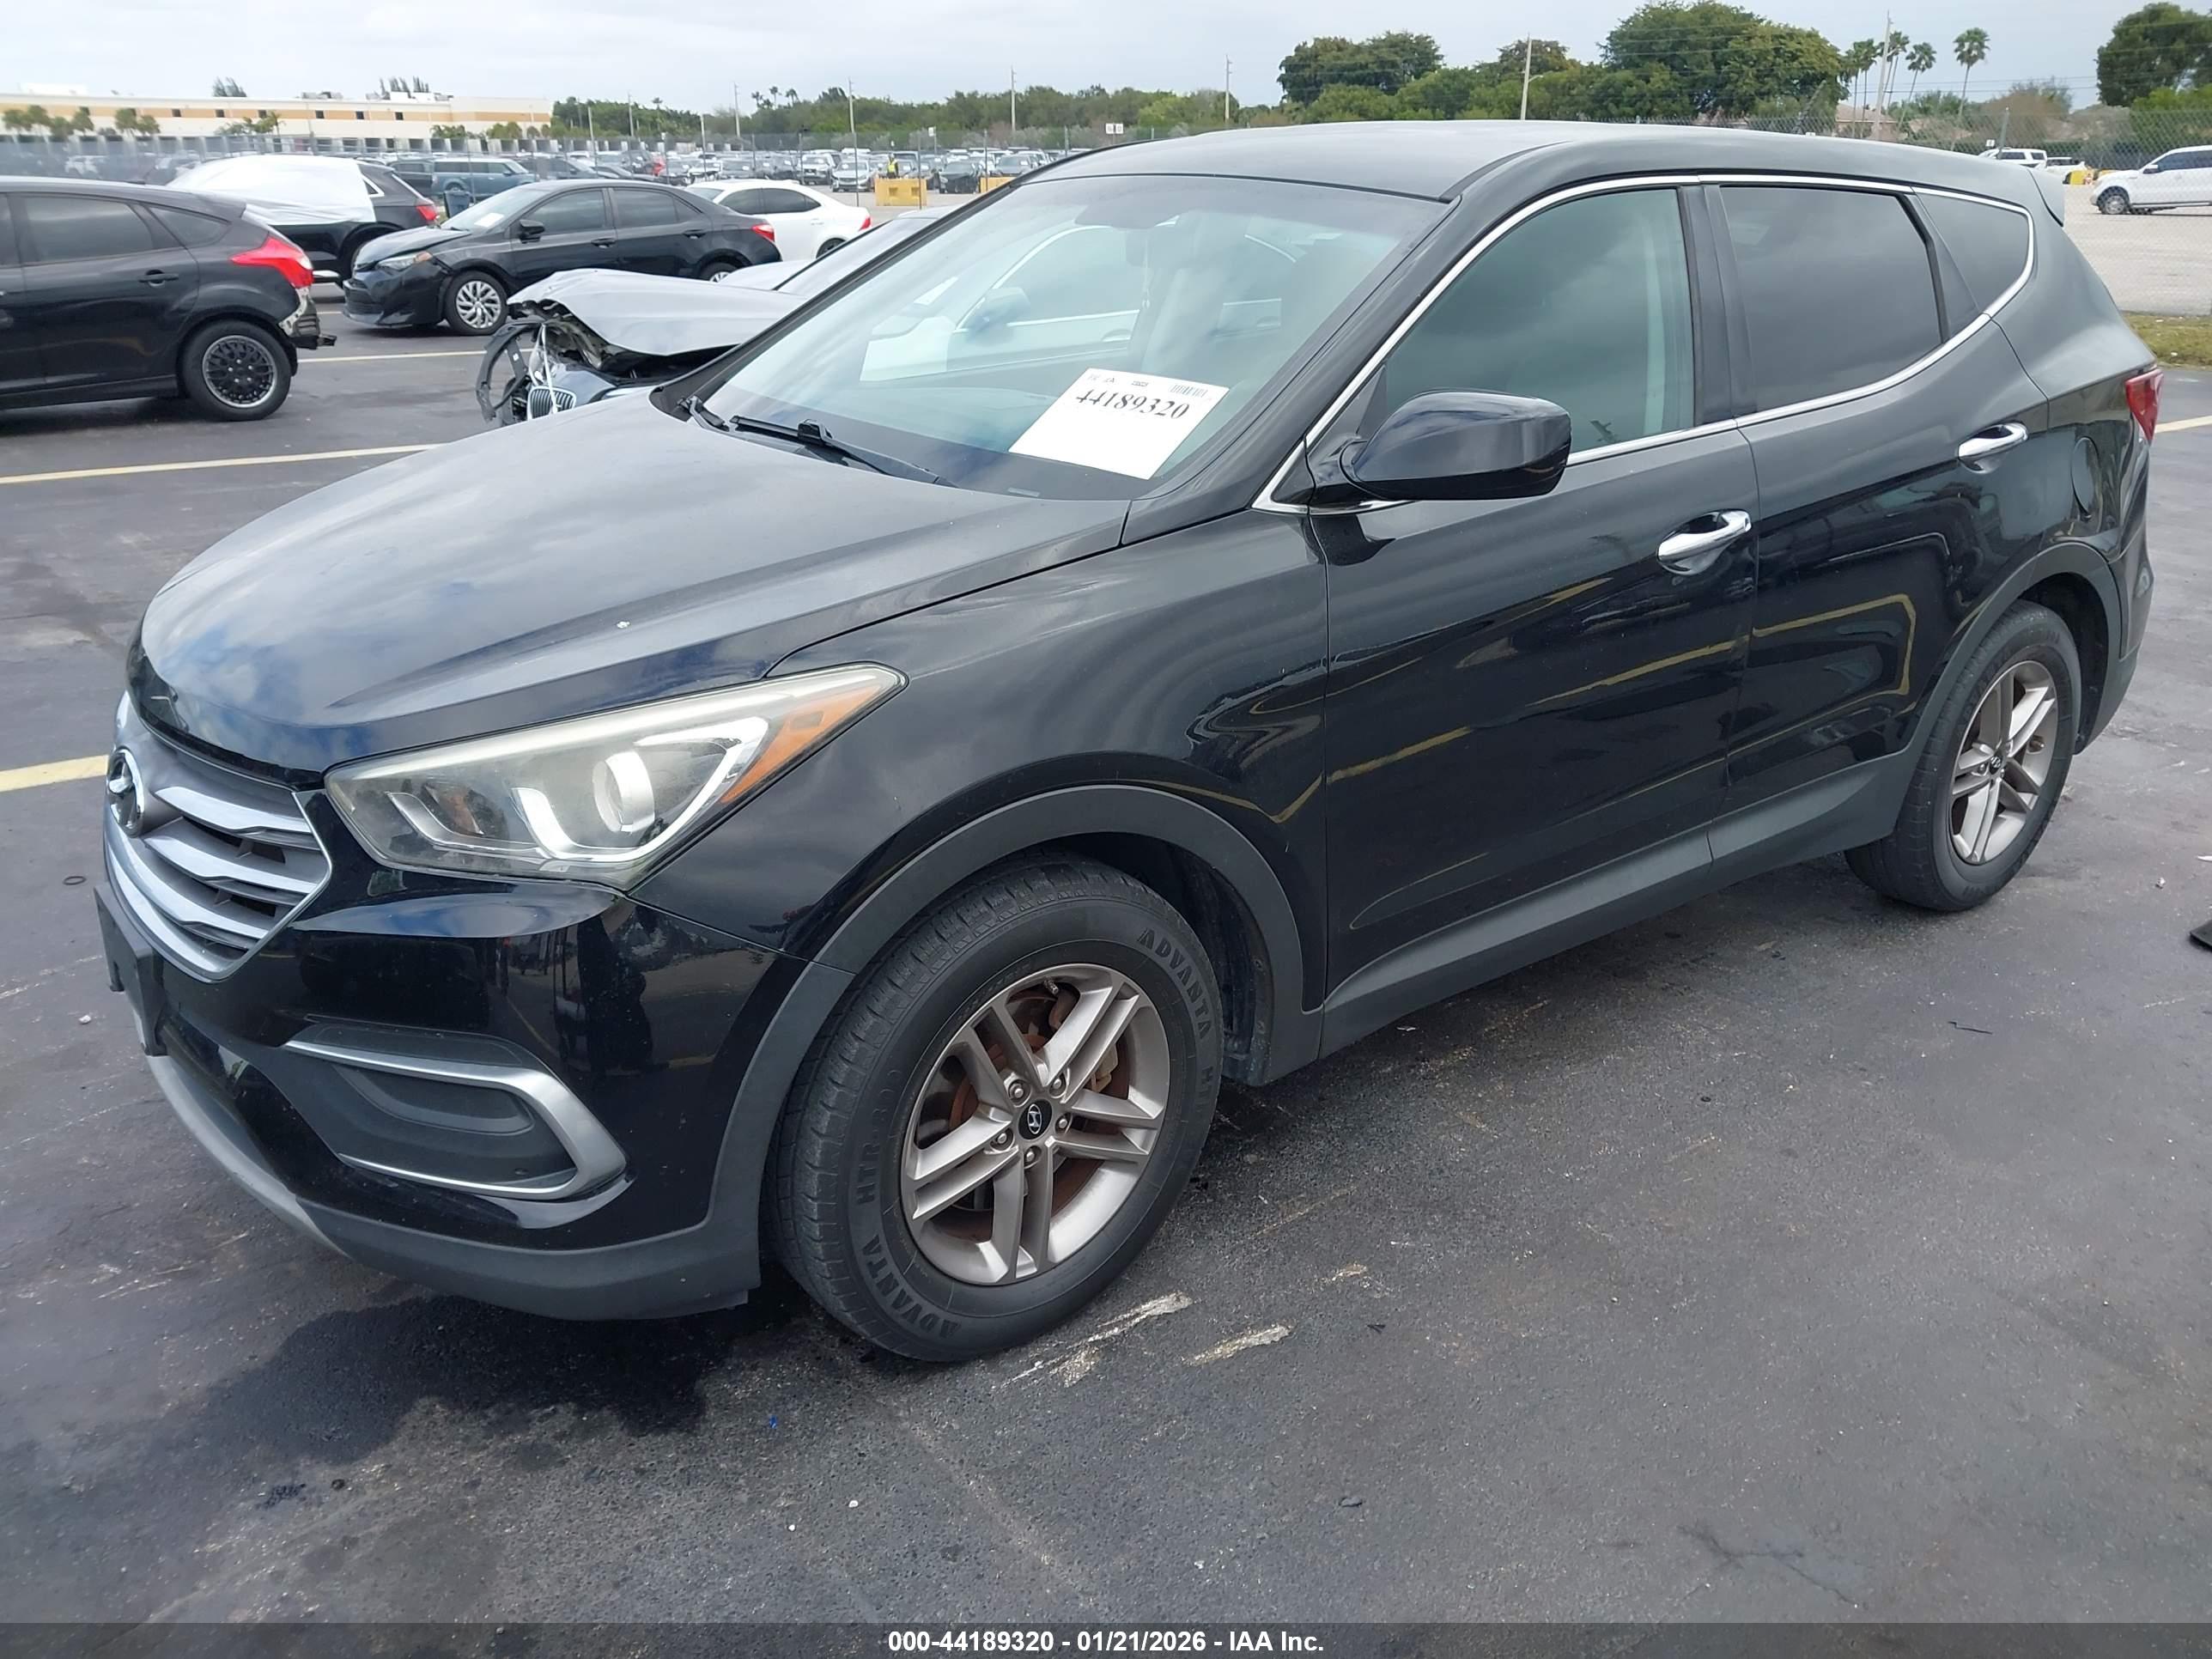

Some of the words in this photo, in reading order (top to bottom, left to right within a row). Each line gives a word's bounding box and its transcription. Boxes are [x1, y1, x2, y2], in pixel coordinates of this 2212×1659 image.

[1075, 389, 1190, 420] 44189320
[1136, 927, 1212, 1039] ADVANTA
[861, 1234, 962, 1339] ADVANTA
